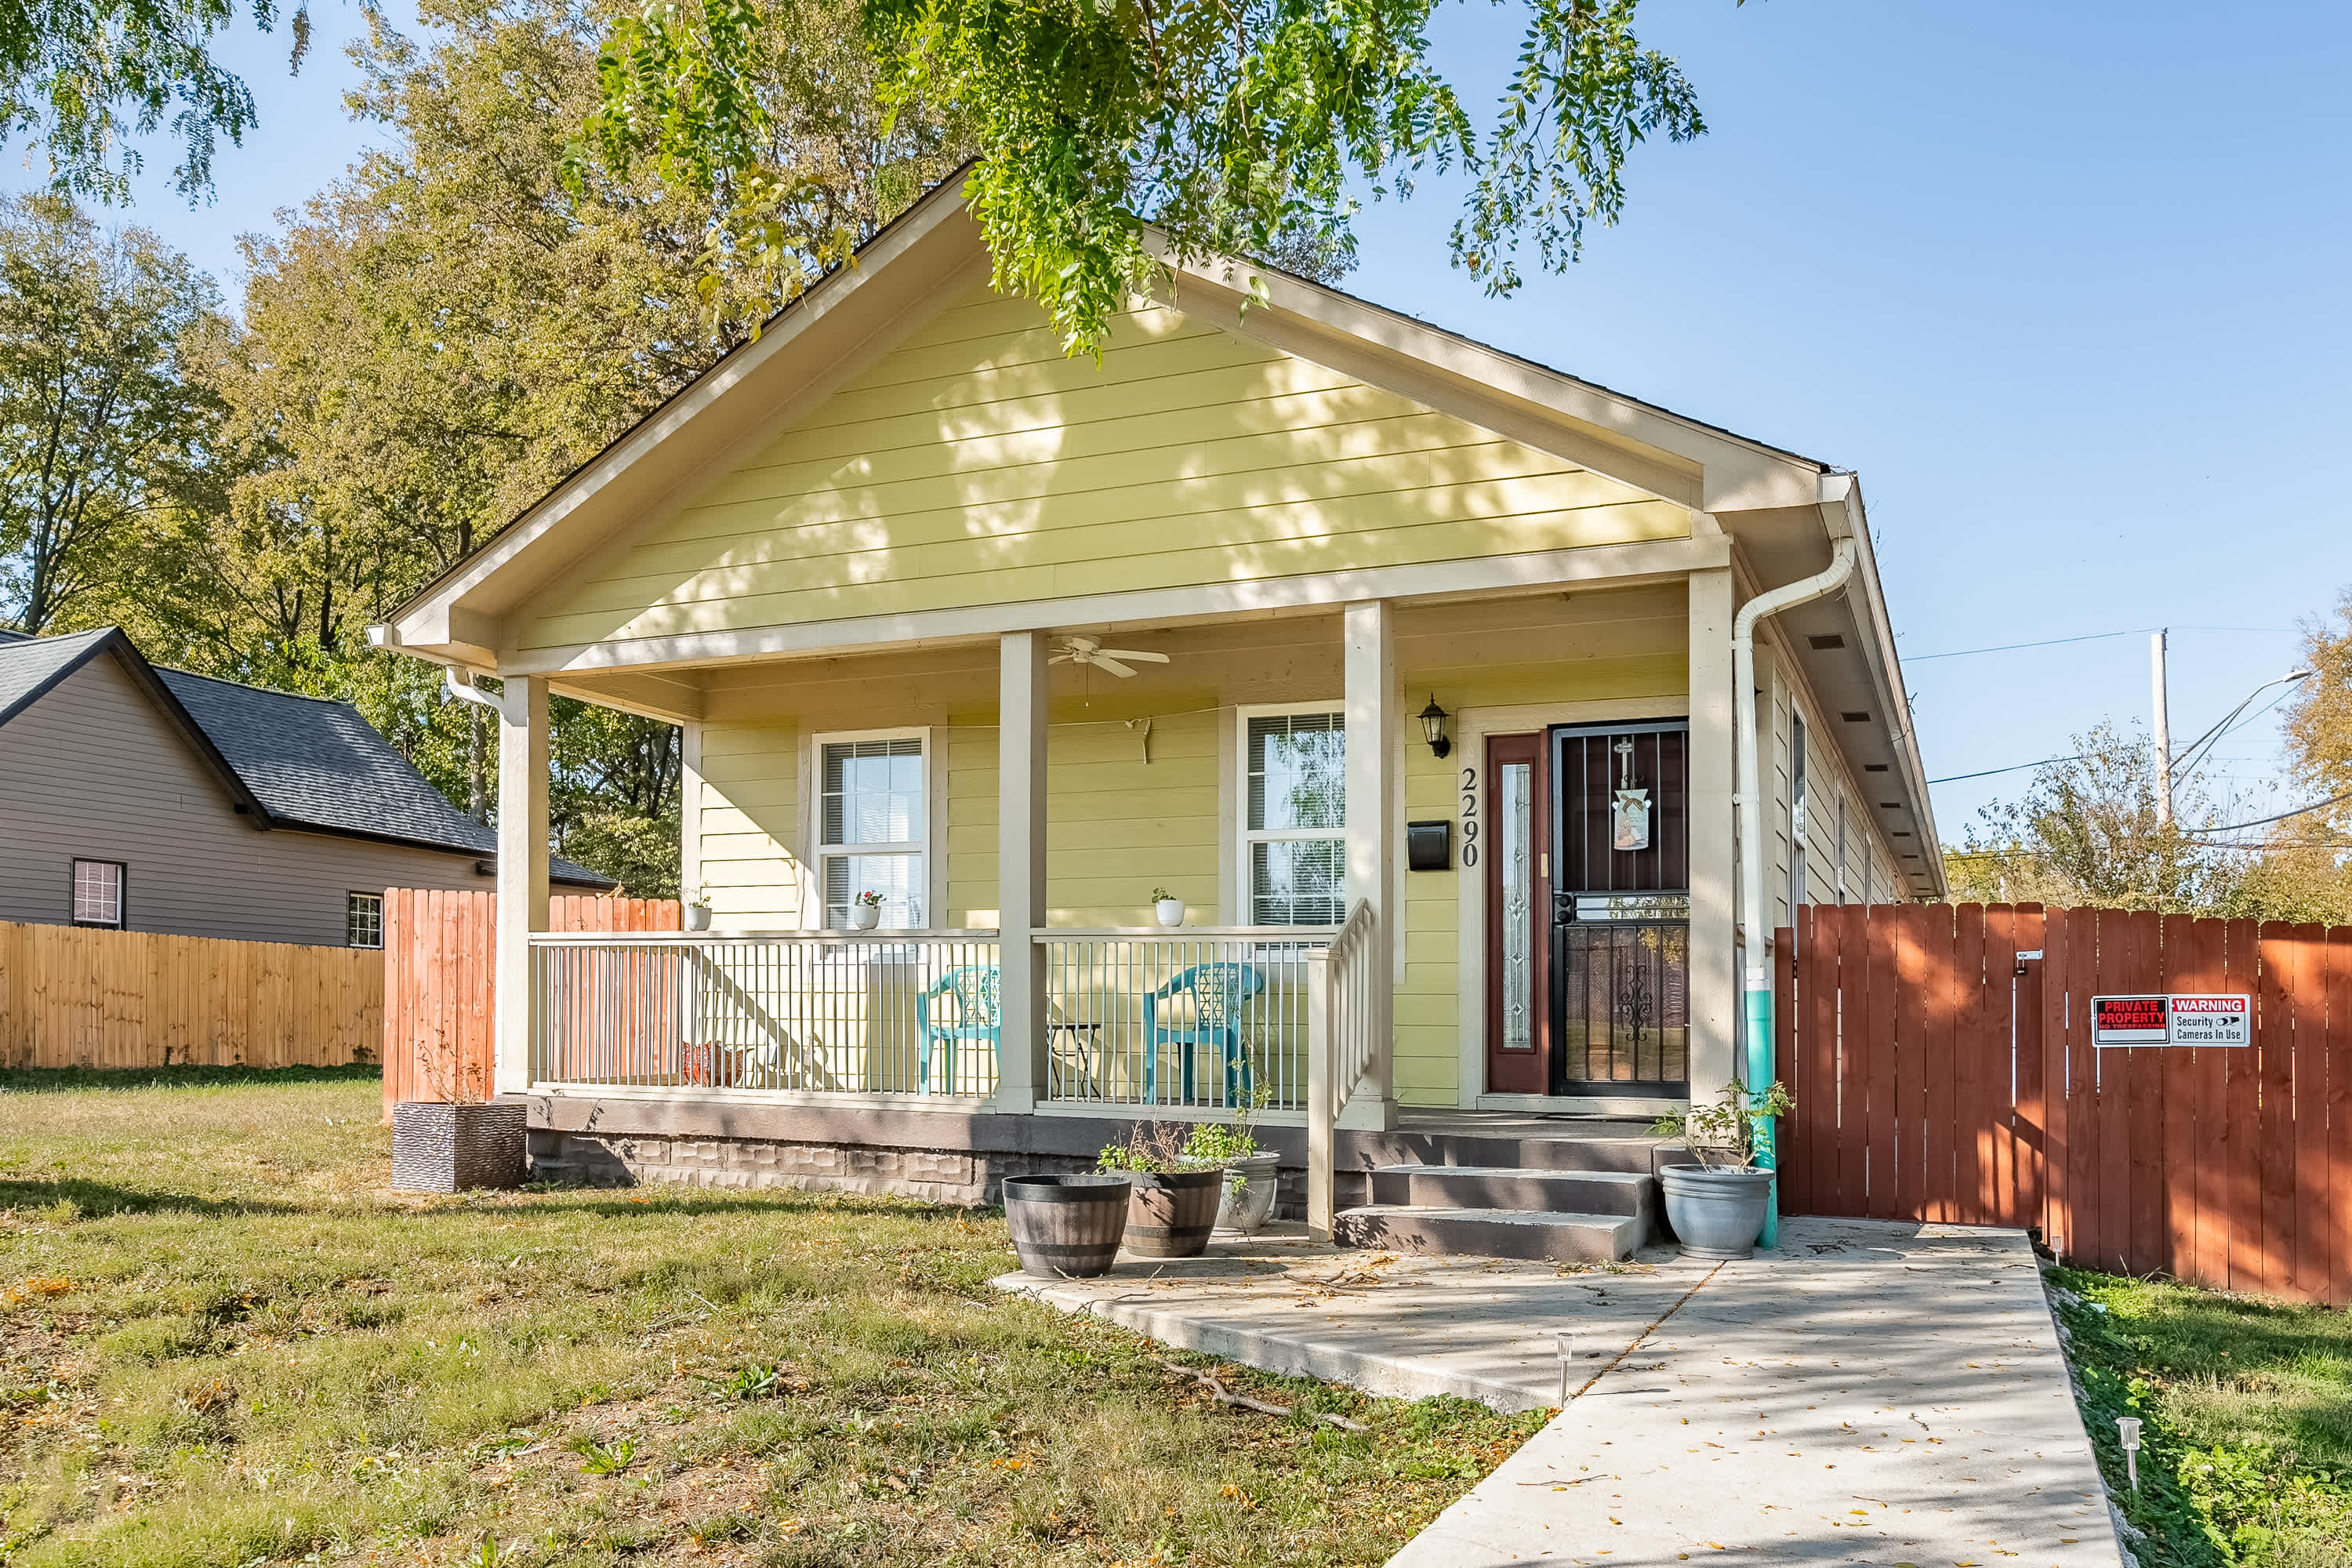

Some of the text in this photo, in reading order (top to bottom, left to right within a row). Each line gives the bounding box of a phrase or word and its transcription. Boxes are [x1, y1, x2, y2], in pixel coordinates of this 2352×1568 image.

[1461, 768, 1479, 867] 2290
[2105, 1000, 2158, 1011] PRIVATE
[2176, 1000, 2242, 1011] WARNING
[2098, 1011, 2165, 1023] PROPERTY
[2176, 1016, 2213, 1028] Security
[2177, 1029, 2241, 1040] Cameras In Use
